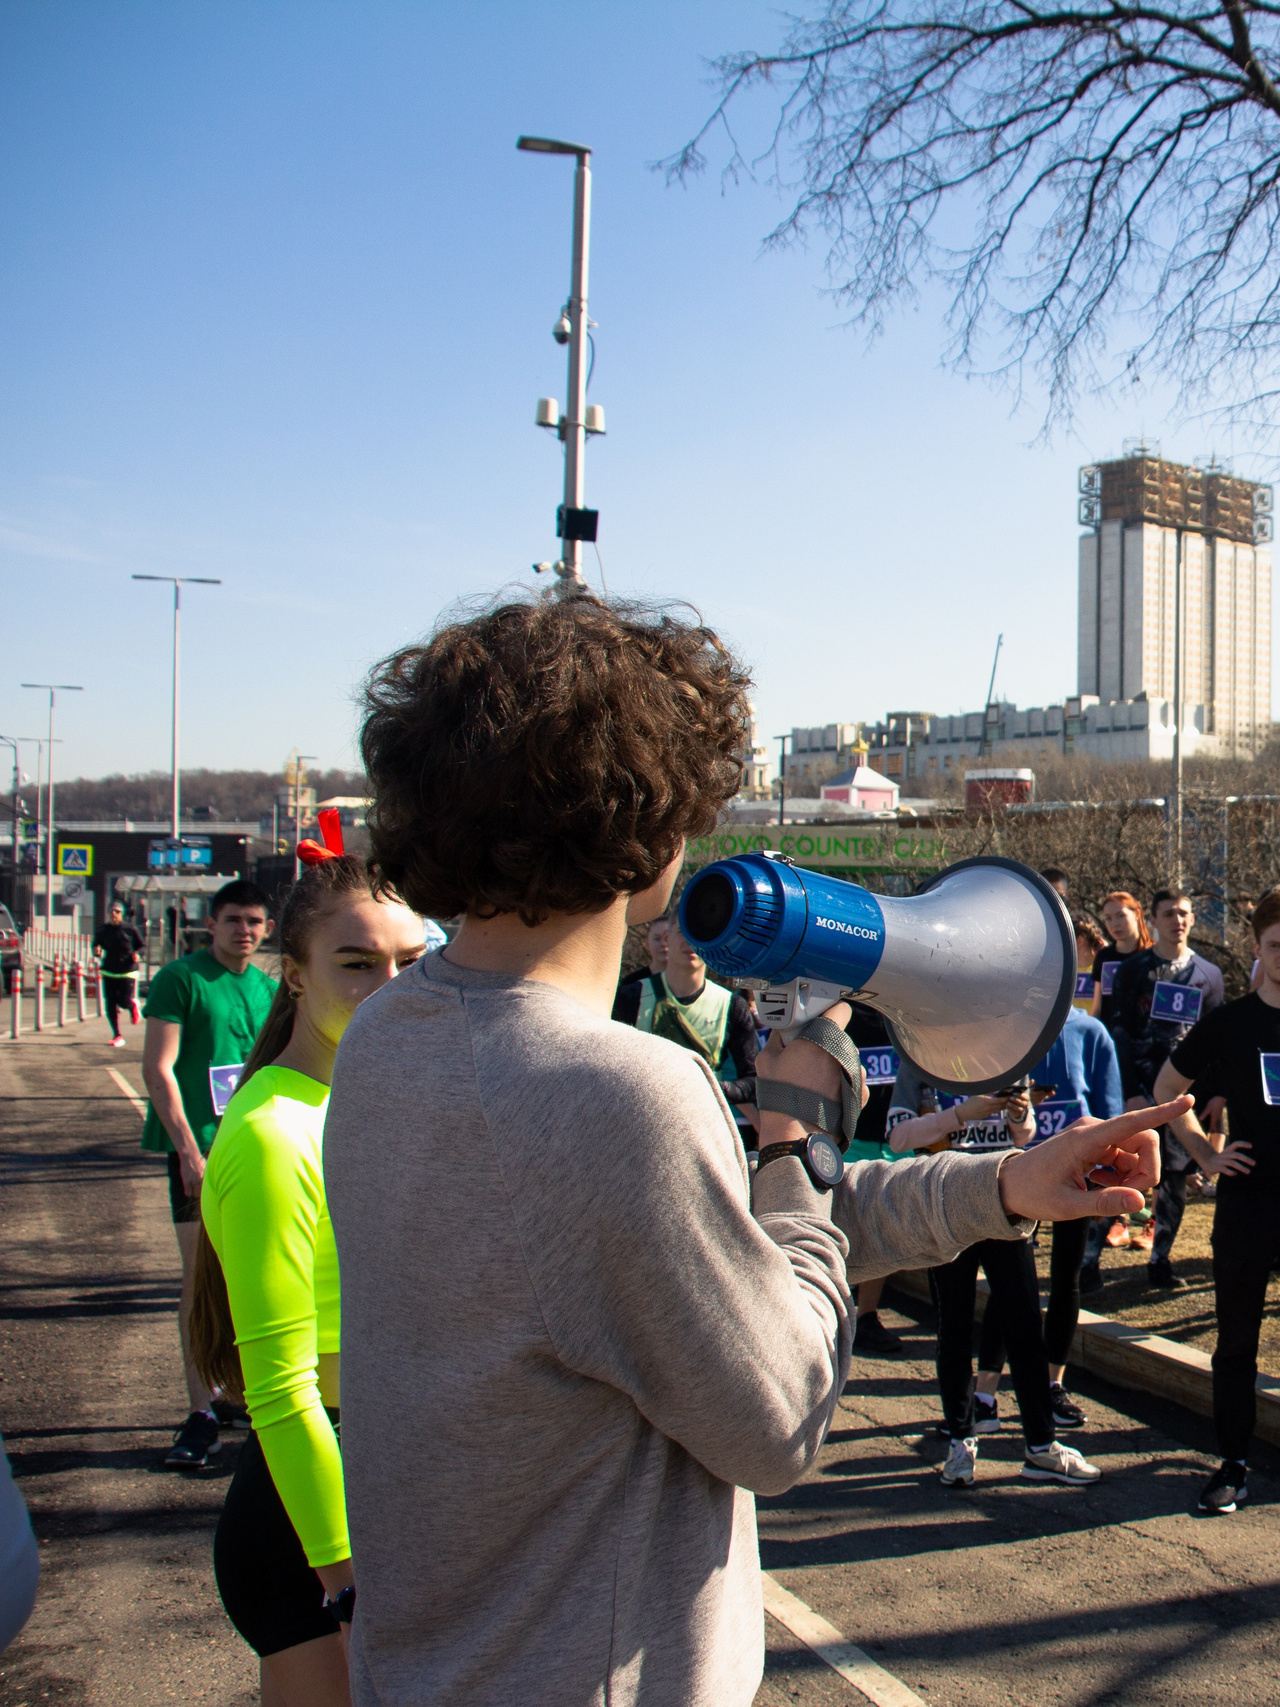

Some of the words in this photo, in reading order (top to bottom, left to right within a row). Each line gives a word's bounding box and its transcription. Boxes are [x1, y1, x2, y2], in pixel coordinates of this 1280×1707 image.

[778, 835, 886, 858] COUNTRY
[1171, 992, 1185, 1012] 8
[866, 1054, 892, 1076] 30
[1038, 1109, 1067, 1135] 32
